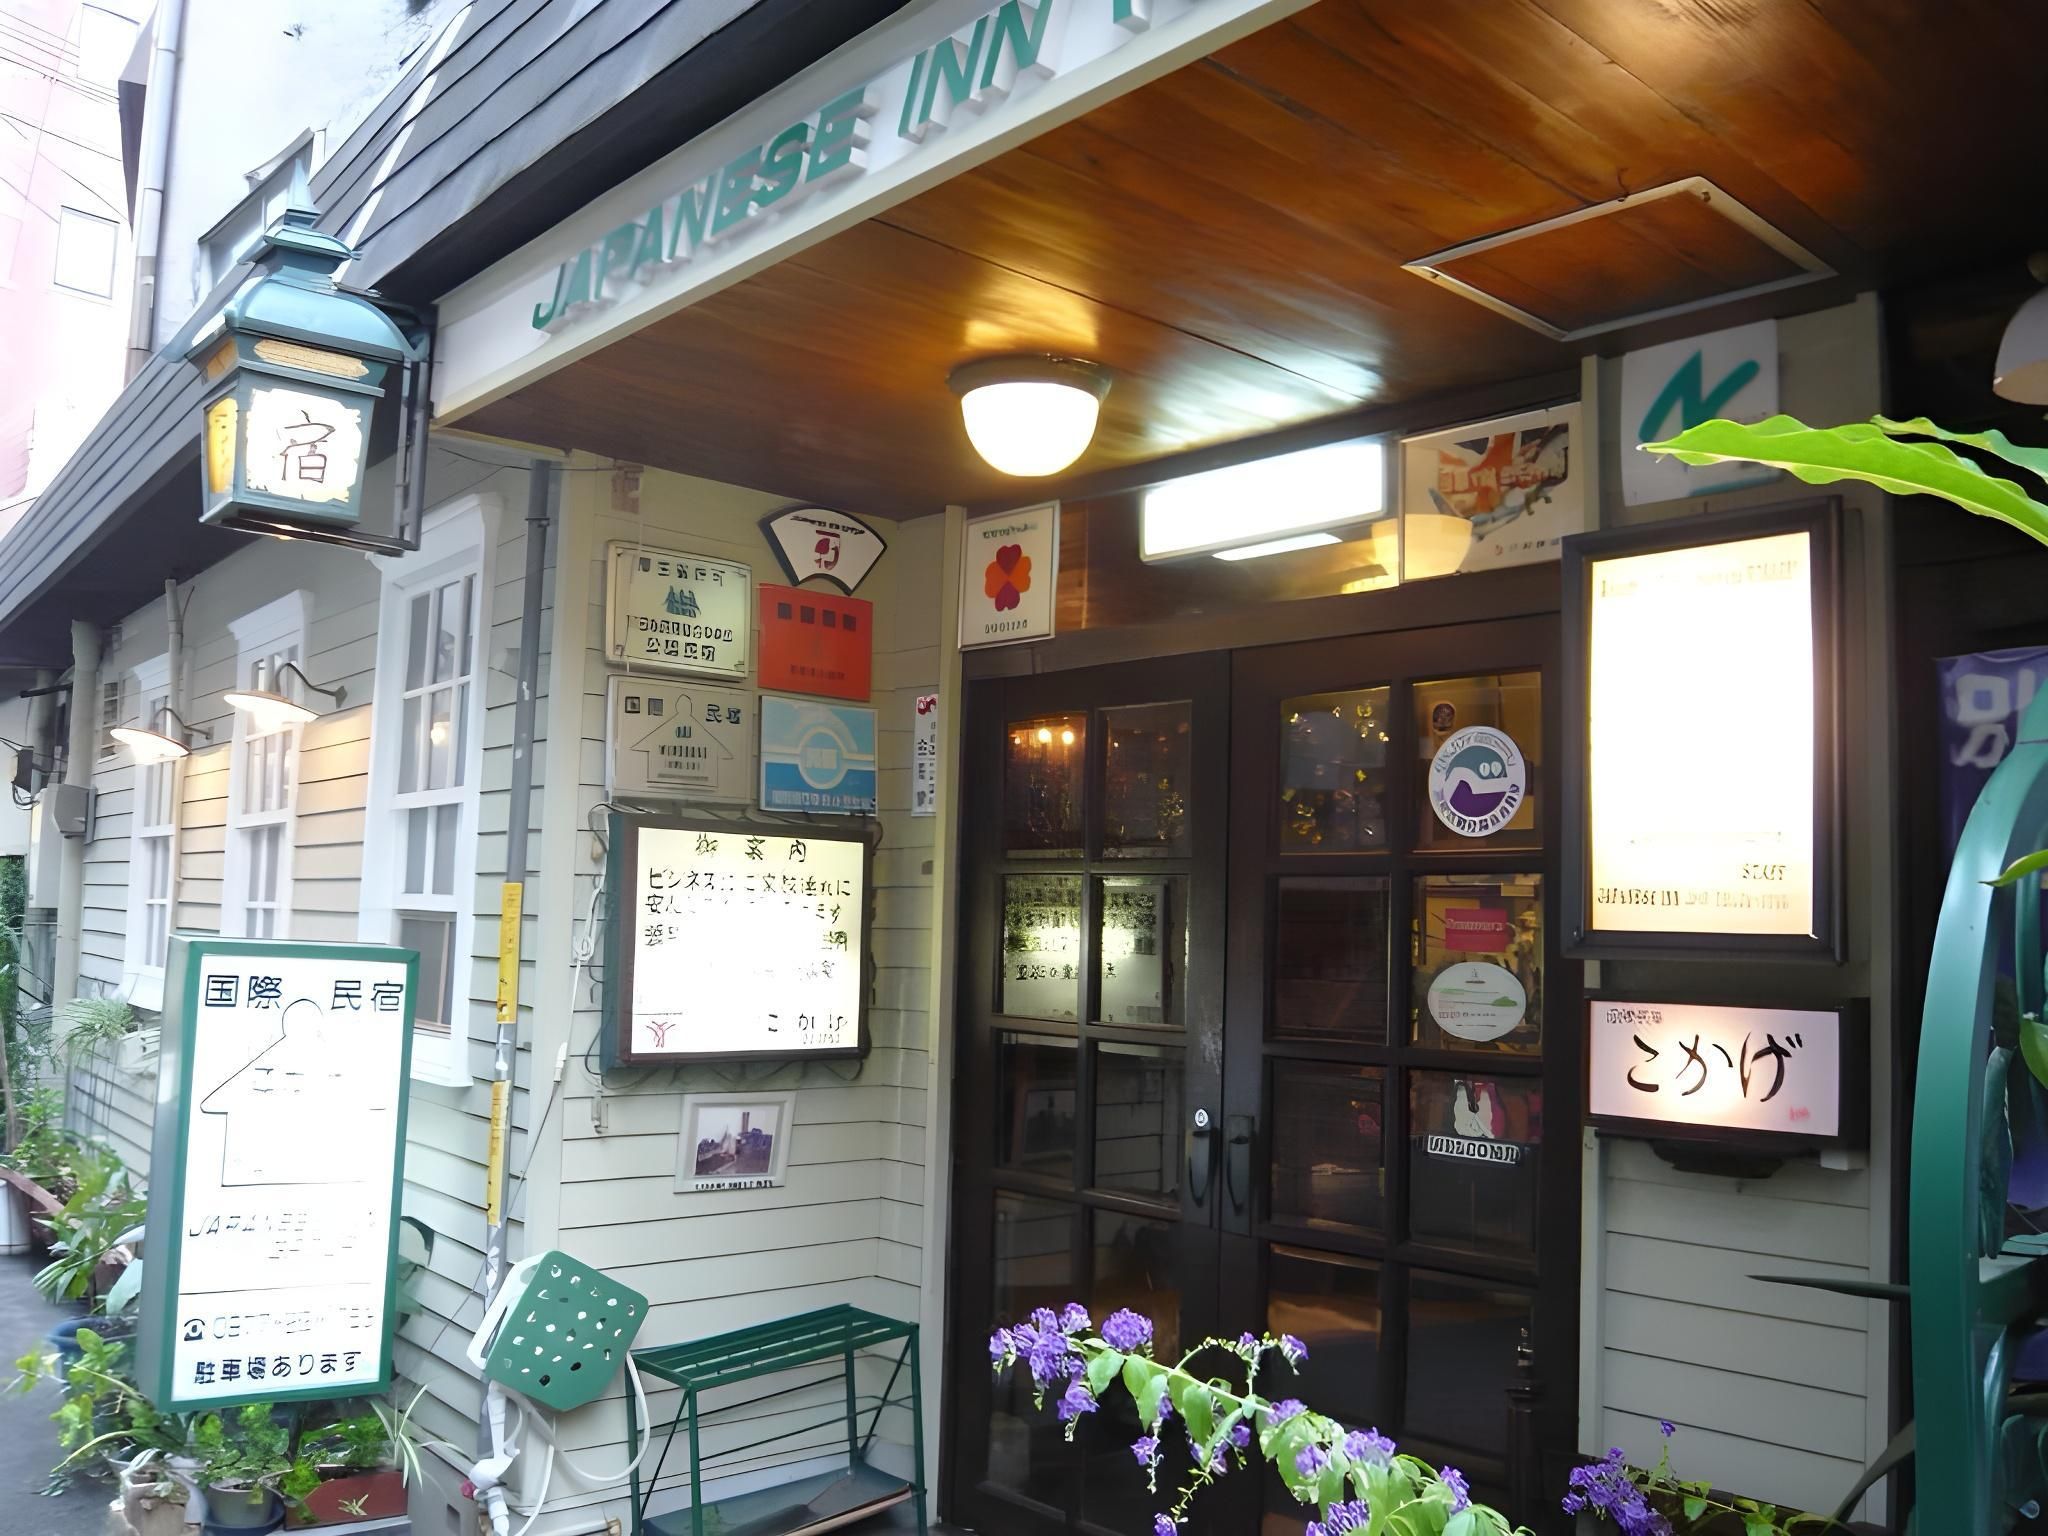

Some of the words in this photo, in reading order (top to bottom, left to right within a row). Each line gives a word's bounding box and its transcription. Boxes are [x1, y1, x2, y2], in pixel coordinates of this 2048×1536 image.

[531, 86, 870, 331] JAPANESE
[898, 0, 1054, 138] INN
[280, 409, 335, 483] 宿
[205, 974, 282, 1009] 国際
[331, 980, 404, 1012] 民宿
[1626, 1031, 1803, 1103] こかげ
